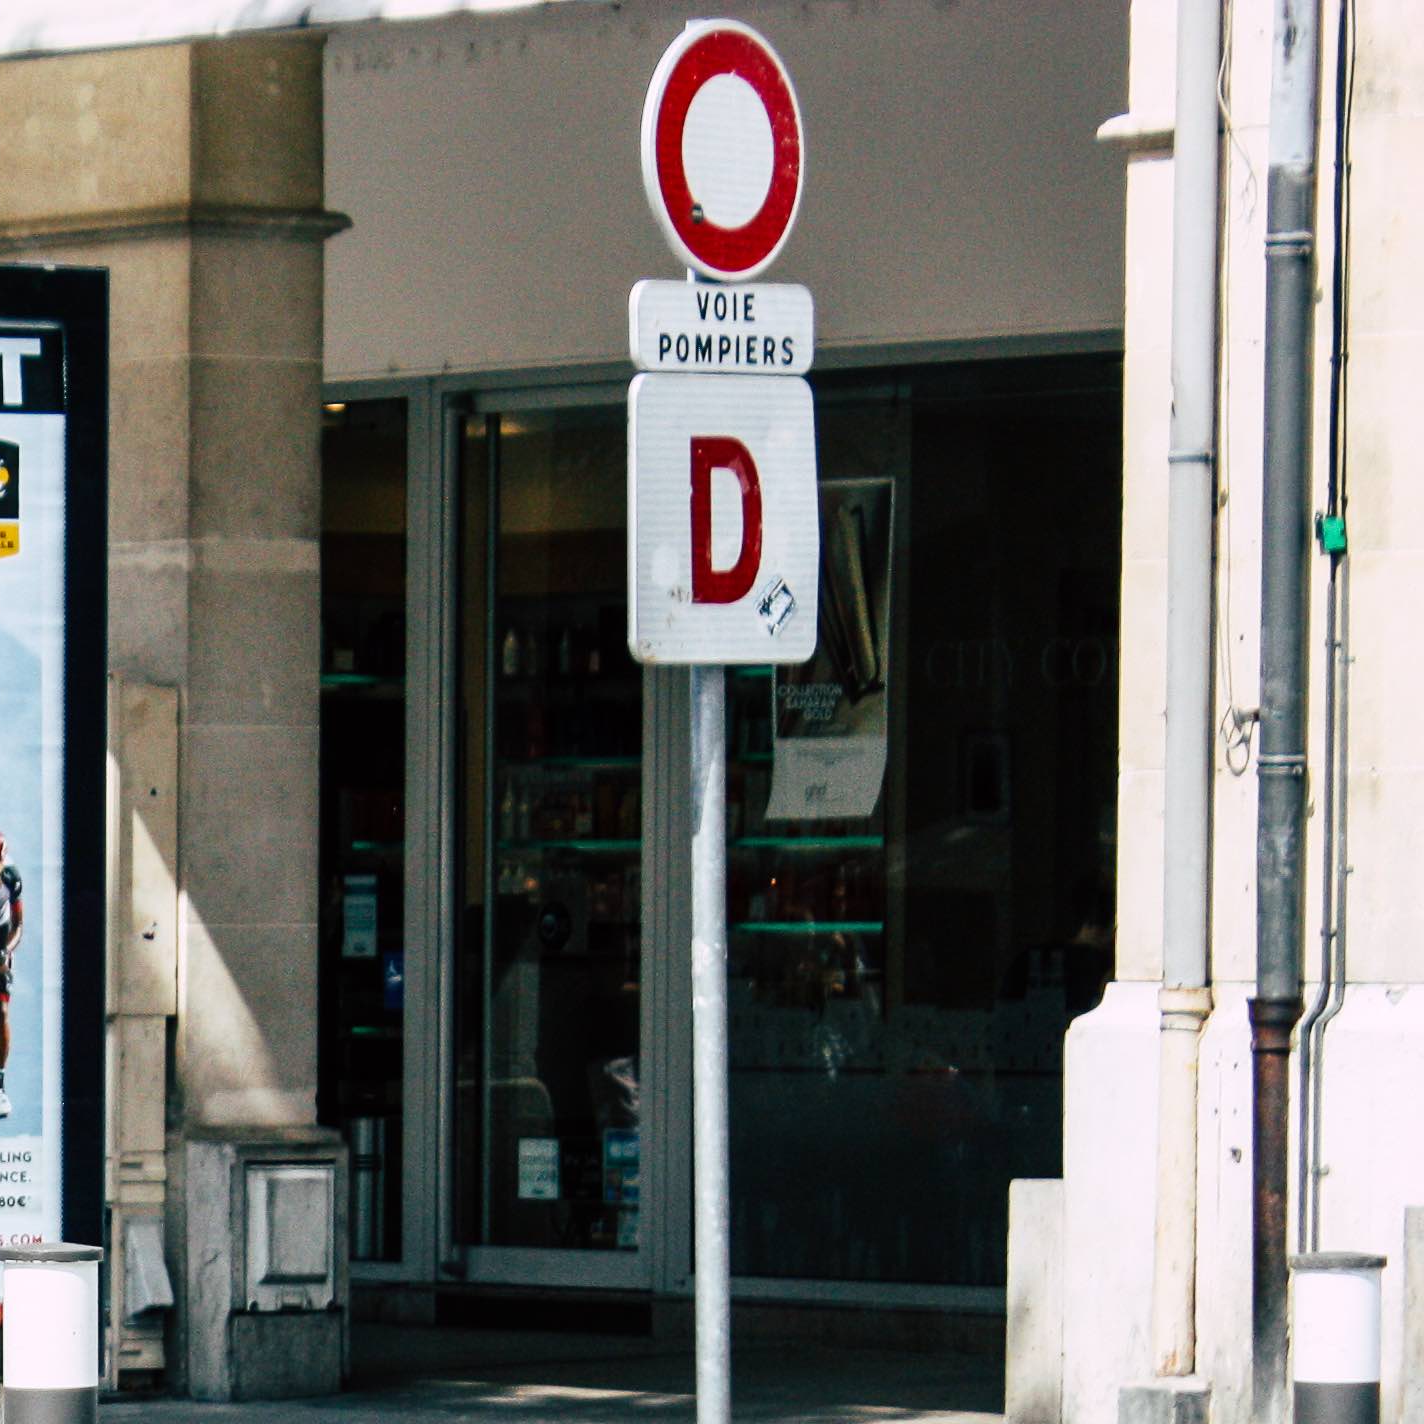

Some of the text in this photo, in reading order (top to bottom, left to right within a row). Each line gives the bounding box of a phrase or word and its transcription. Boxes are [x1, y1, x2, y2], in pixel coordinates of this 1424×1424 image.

[697, 291, 756, 322] VOIE
[659, 332, 795, 366] POMPIERS
[690, 433, 763, 605] D
